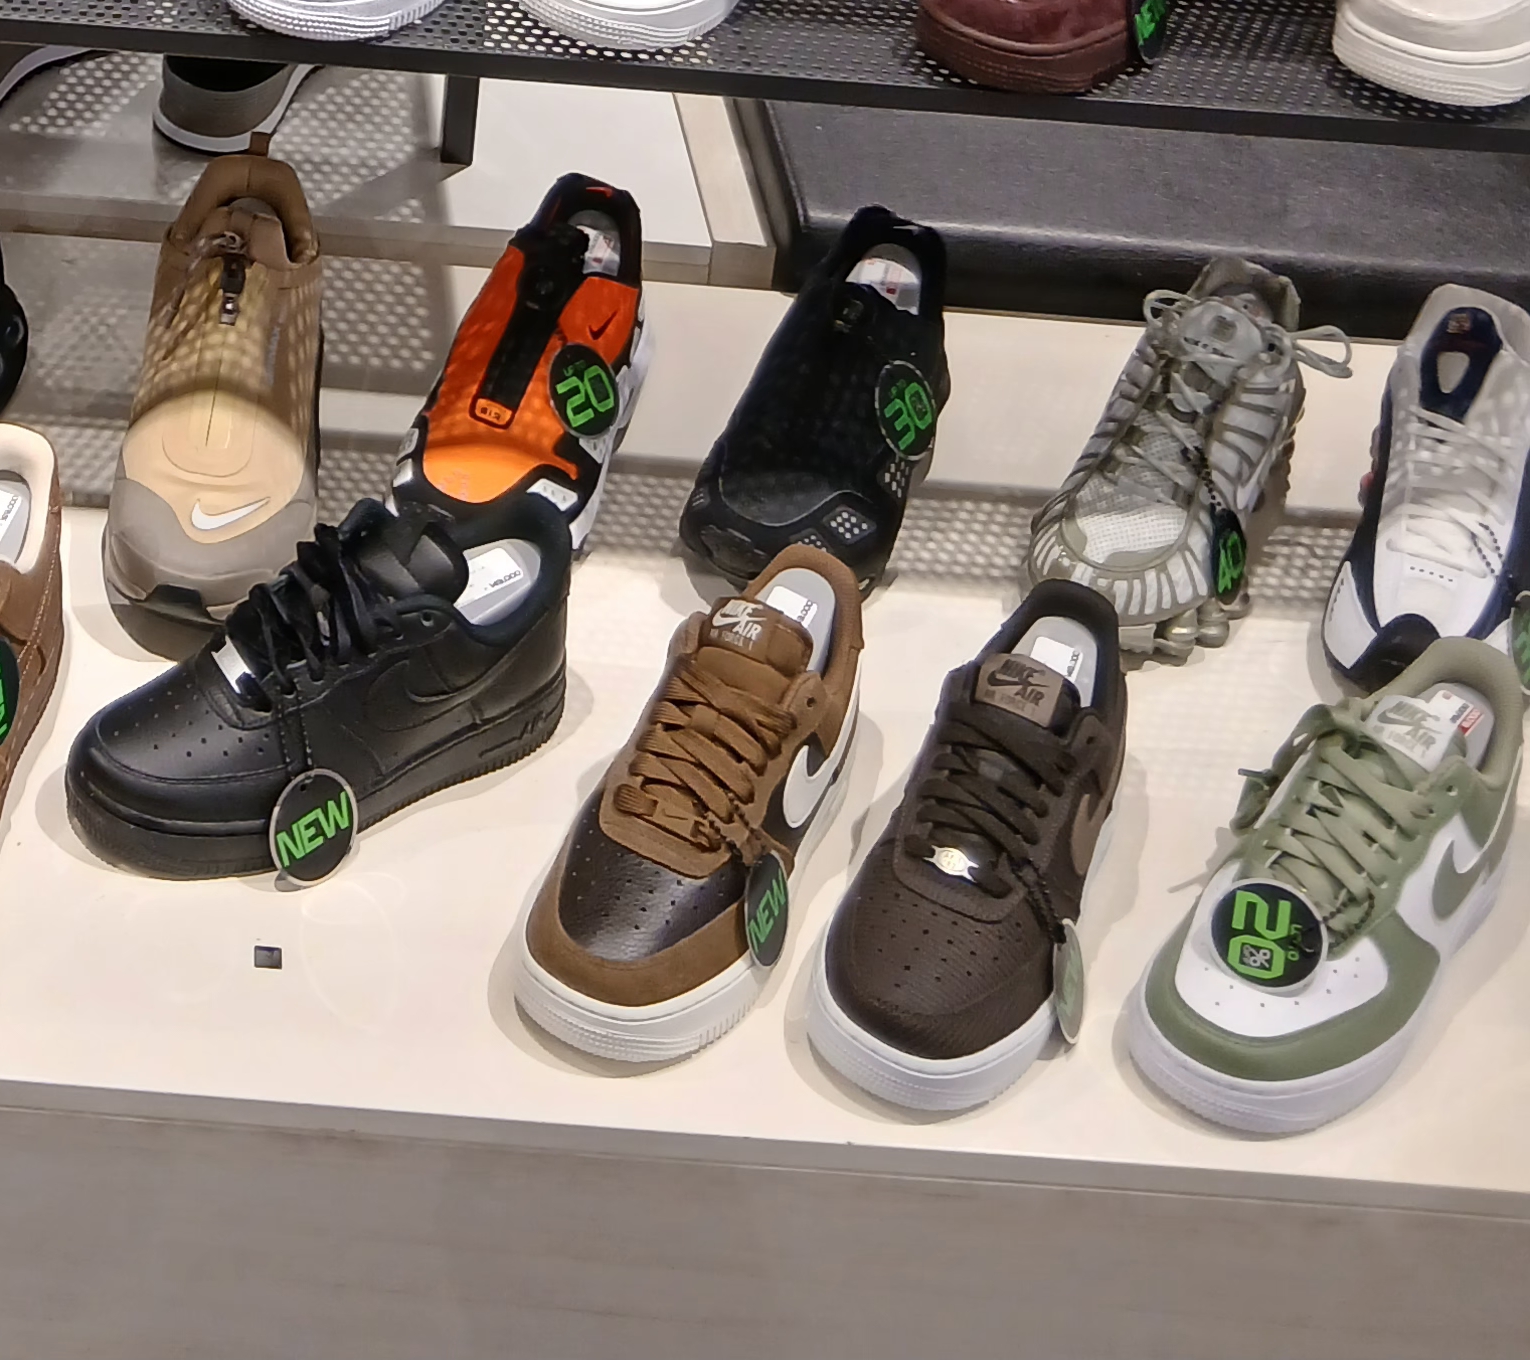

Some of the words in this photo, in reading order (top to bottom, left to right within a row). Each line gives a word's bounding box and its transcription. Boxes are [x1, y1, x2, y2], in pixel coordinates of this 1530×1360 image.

[556, 369, 614, 428] 20
[731, 623, 761, 641] AIR
[1014, 686, 1045, 707] AIR
[276, 791, 350, 867] NEW
[751, 878, 786, 952] NEW
